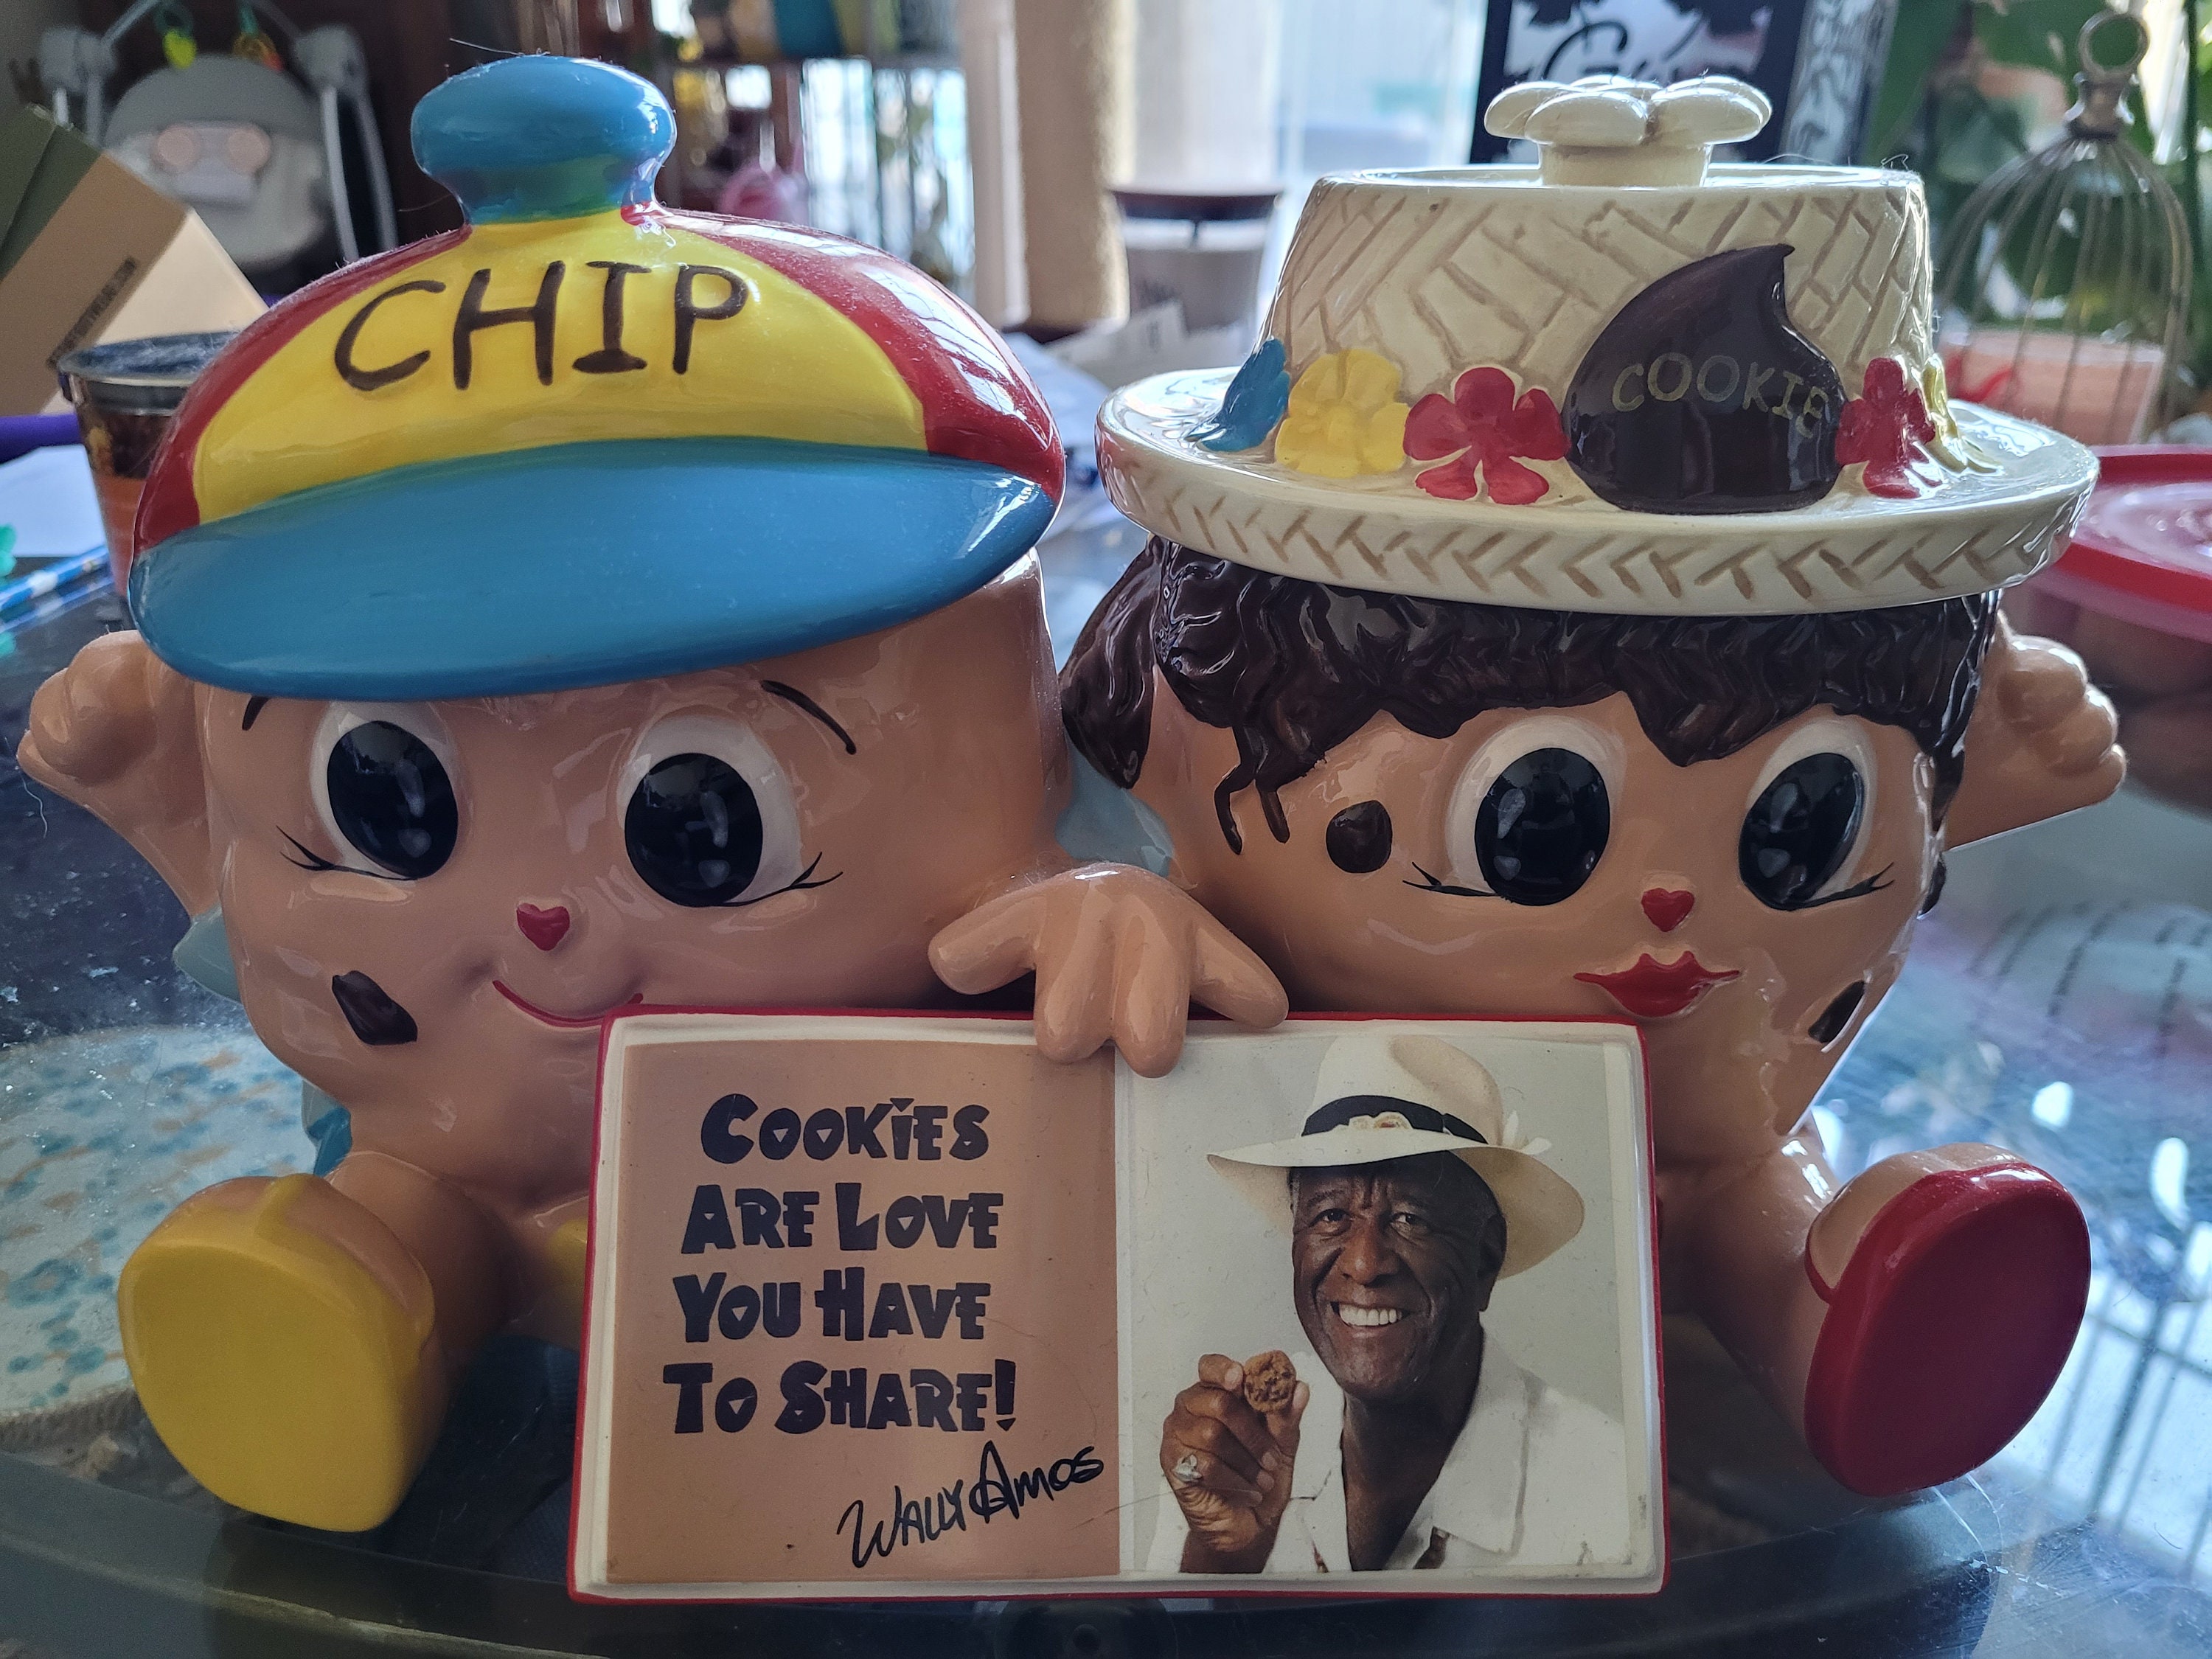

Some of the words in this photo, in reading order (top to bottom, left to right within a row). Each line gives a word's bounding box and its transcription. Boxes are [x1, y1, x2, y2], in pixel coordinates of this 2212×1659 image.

[334, 260, 748, 391] CHIP
[1612, 352, 1829, 439] COOKIE
[700, 1093, 990, 1164] COOKIES
[681, 1184, 820, 1254] ARE
[835, 1182, 1004, 1251] LOVE
[672, 1272, 801, 1343] YOU
[814, 1266, 991, 1341] HAVE
[663, 1363, 758, 1434] TO
[773, 1359, 1016, 1434] SHARE!
[836, 1479, 967, 1568] WALLY
[968, 1440, 1105, 1524] AMOS
